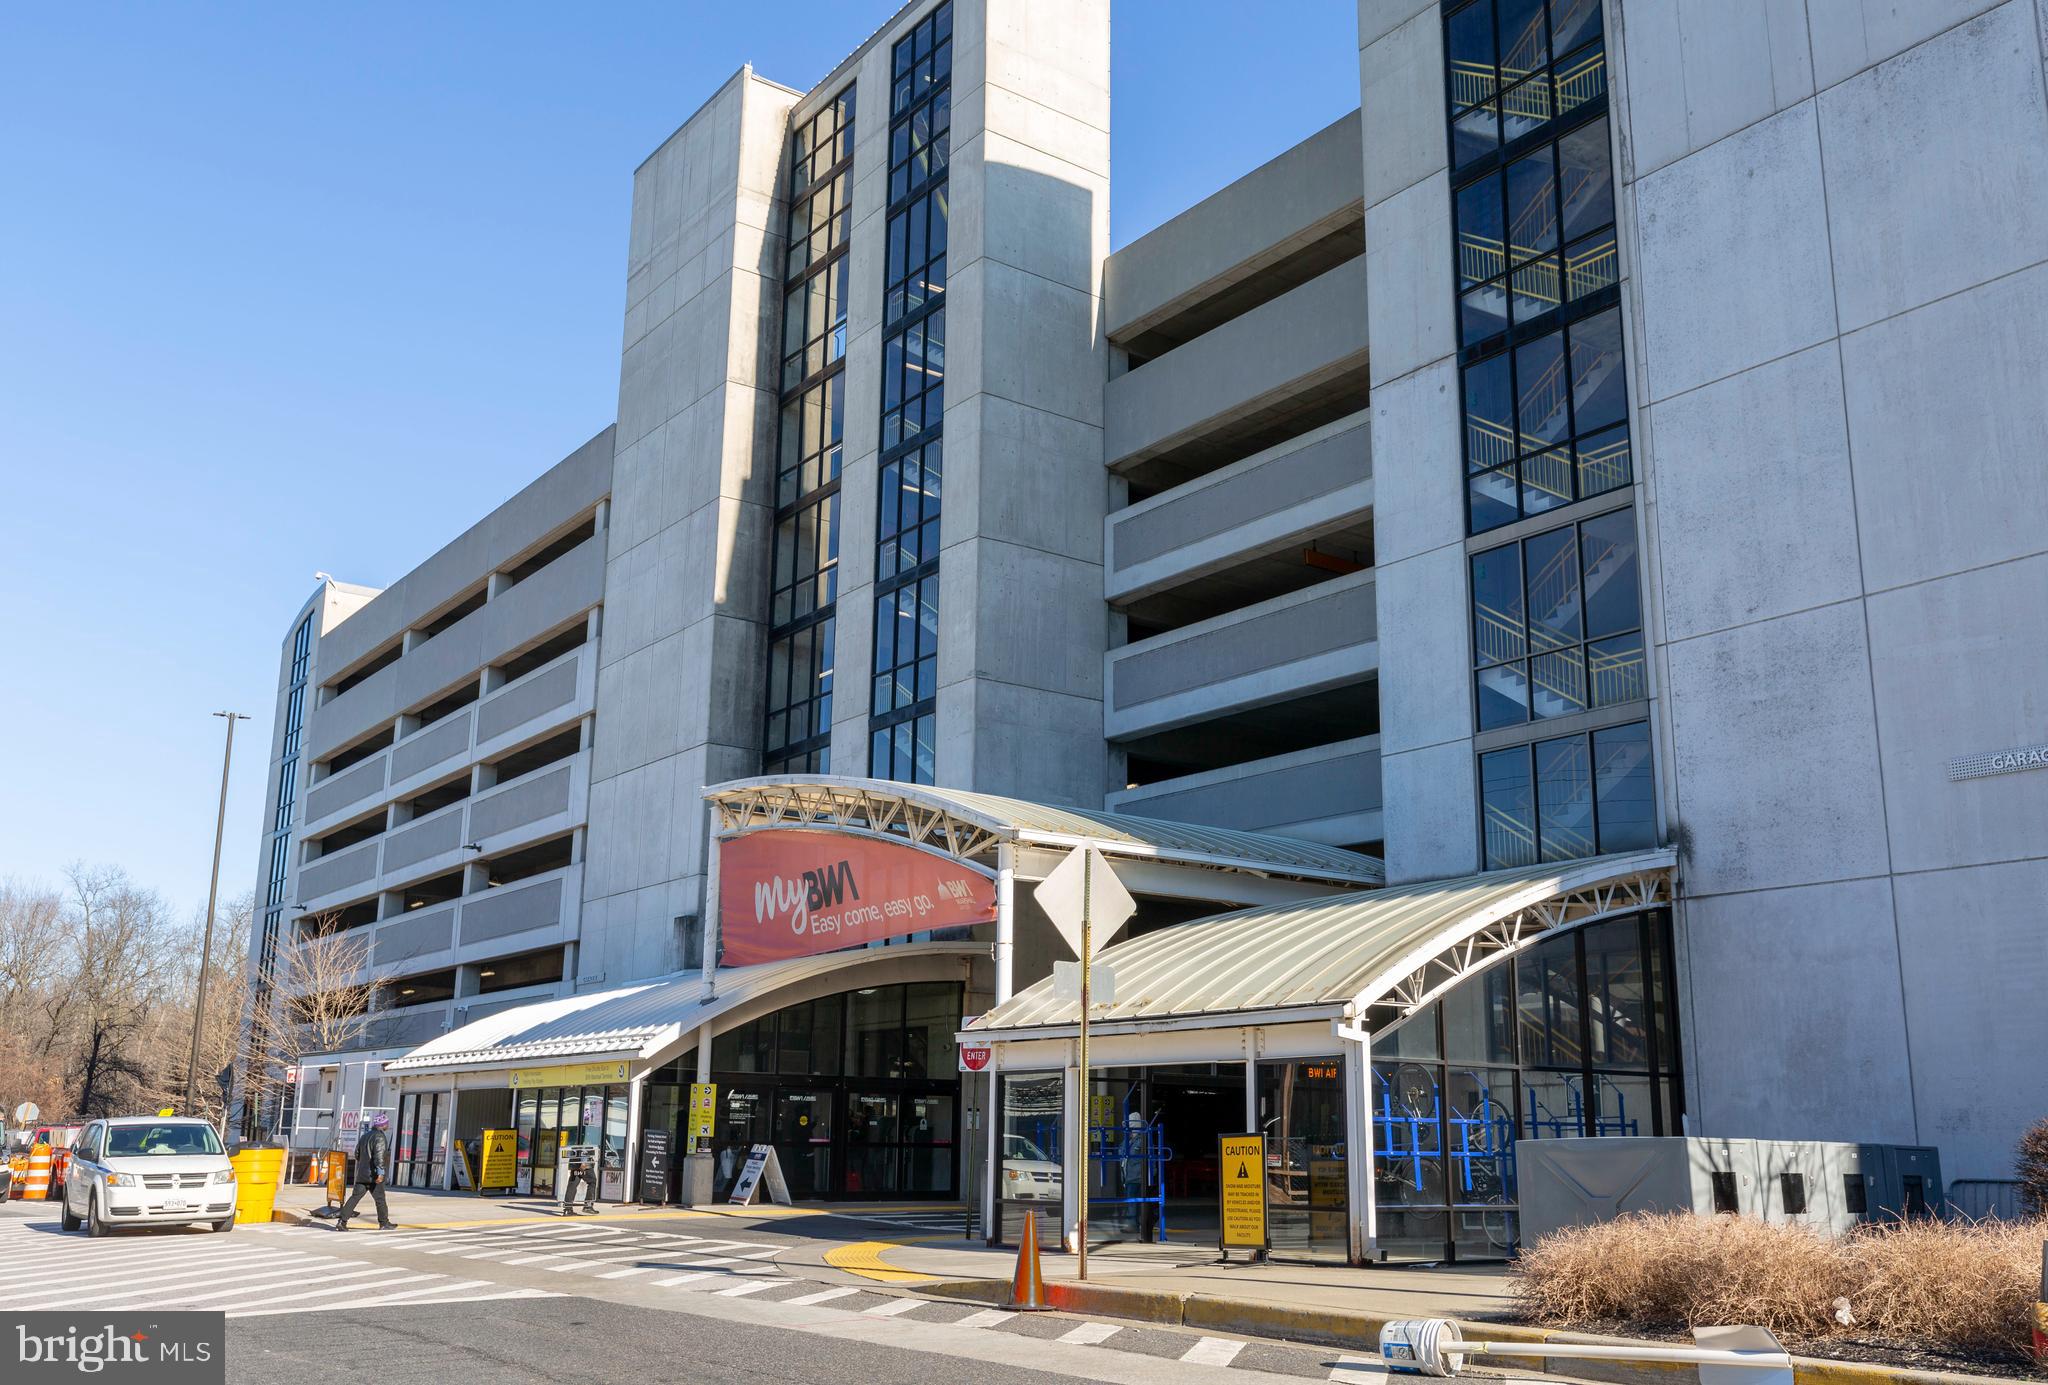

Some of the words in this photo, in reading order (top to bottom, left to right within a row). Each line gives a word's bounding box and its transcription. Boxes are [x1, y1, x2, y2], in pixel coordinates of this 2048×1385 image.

[810, 912, 841, 935] Easy
[844, 903, 884, 925] come,
[884, 896, 913, 918] easy
[914, 893, 935, 916] go.
[967, 1051, 986, 1060] ENTER
[1308, 1067, 1324, 1078] BWI
[342, 1112, 359, 1129] KCC
[1225, 1145, 1260, 1156] CAUTION
